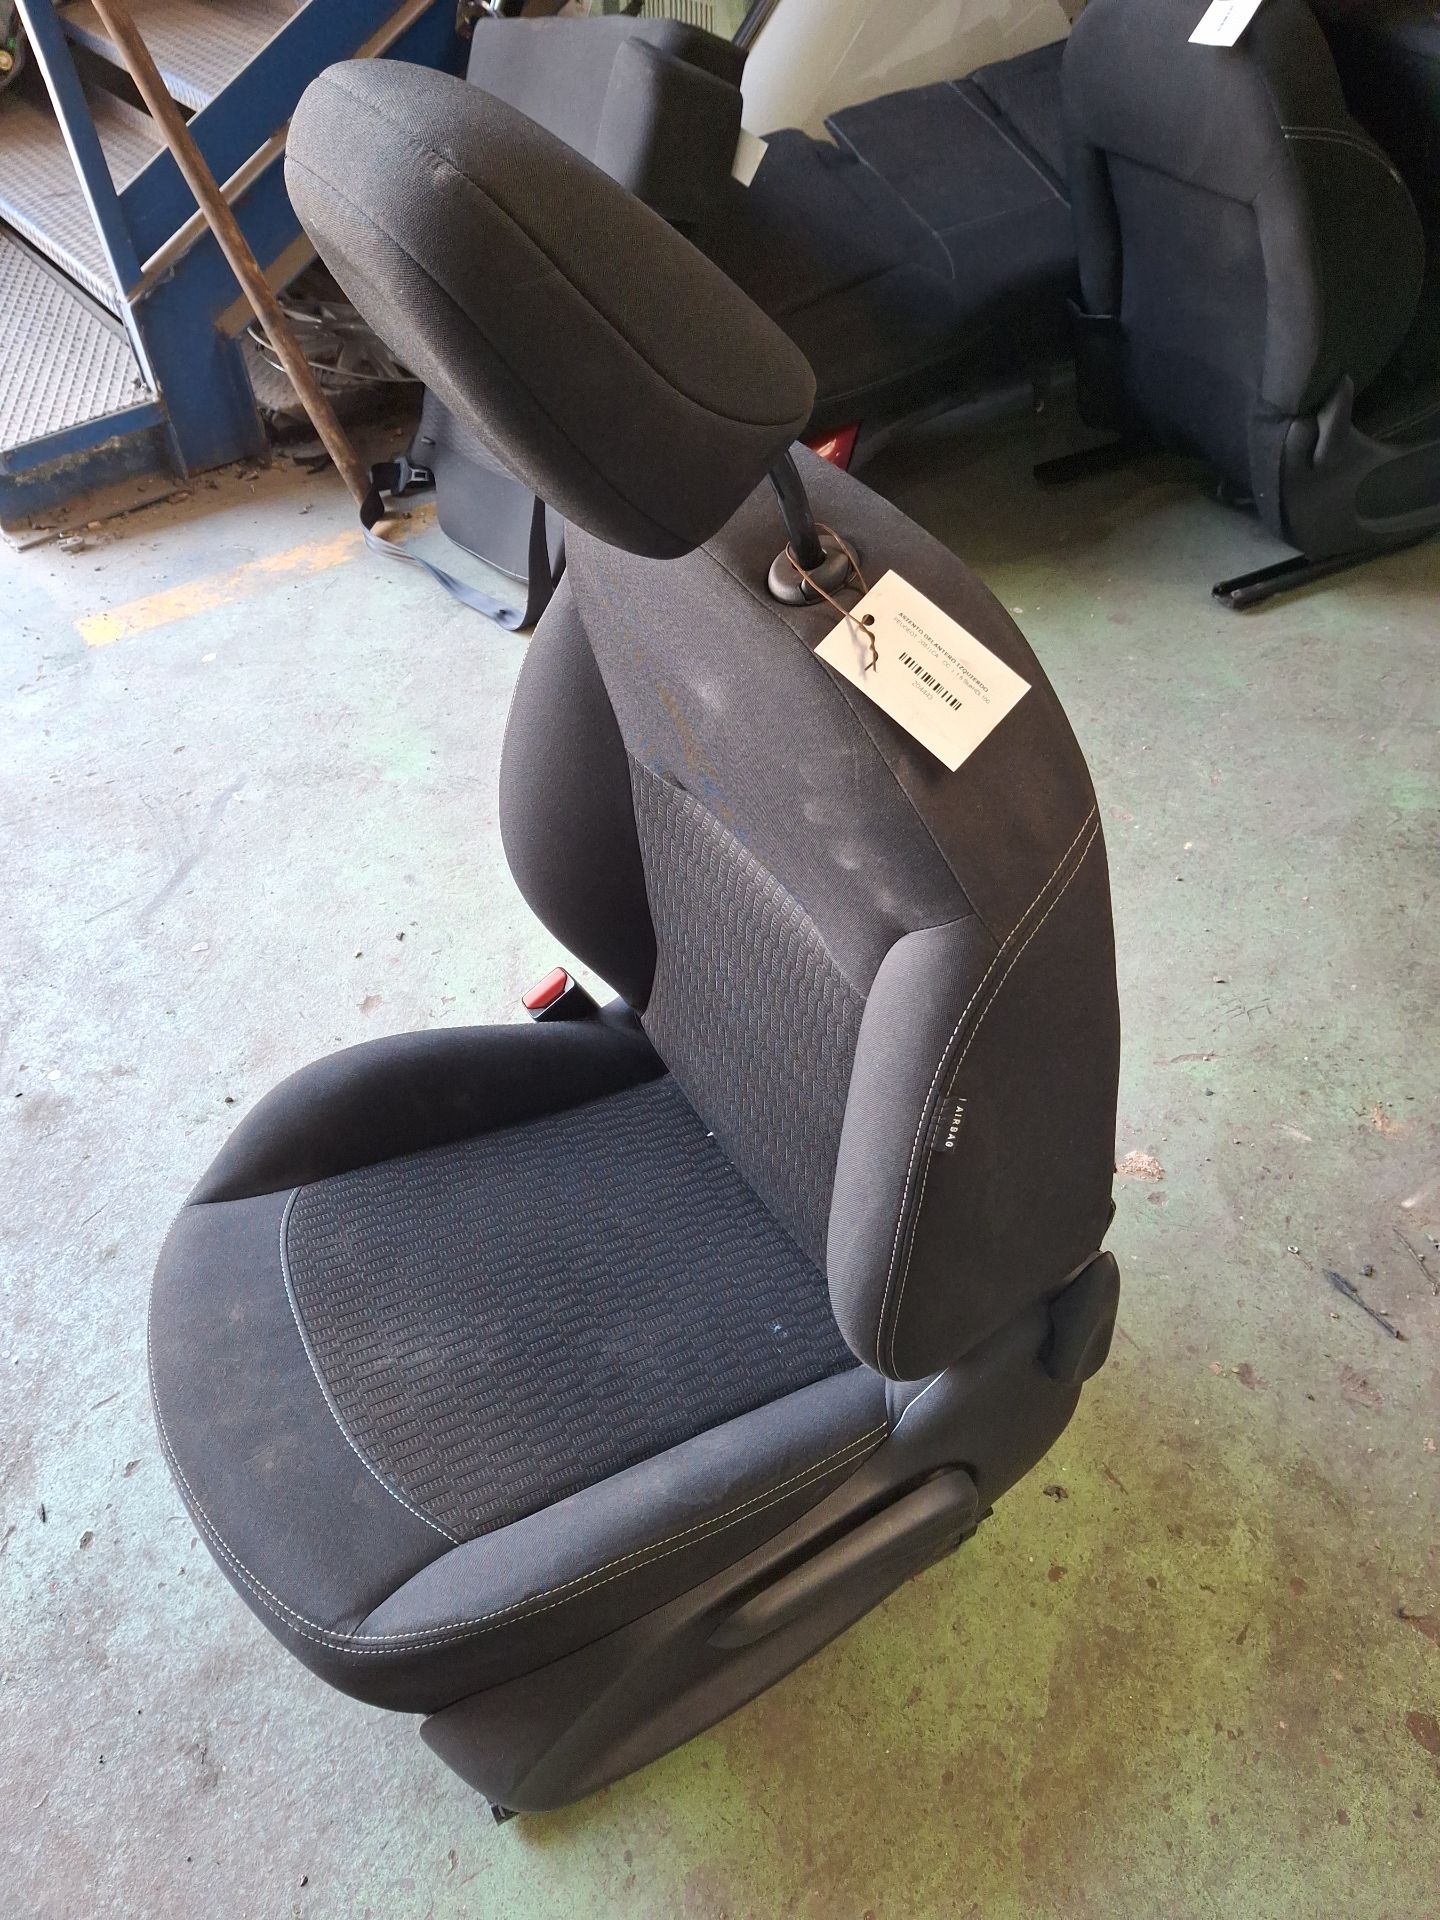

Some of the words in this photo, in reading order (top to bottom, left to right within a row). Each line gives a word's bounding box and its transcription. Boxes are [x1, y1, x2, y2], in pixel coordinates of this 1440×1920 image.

[898, 612, 924, 635] ASIENTO
[923, 633, 957, 663] DELANTERO
[956, 663, 989, 693] IZQUIERDO
[911, 680, 934, 701] 204443
[945, 1106, 964, 1147] AIRBAG
